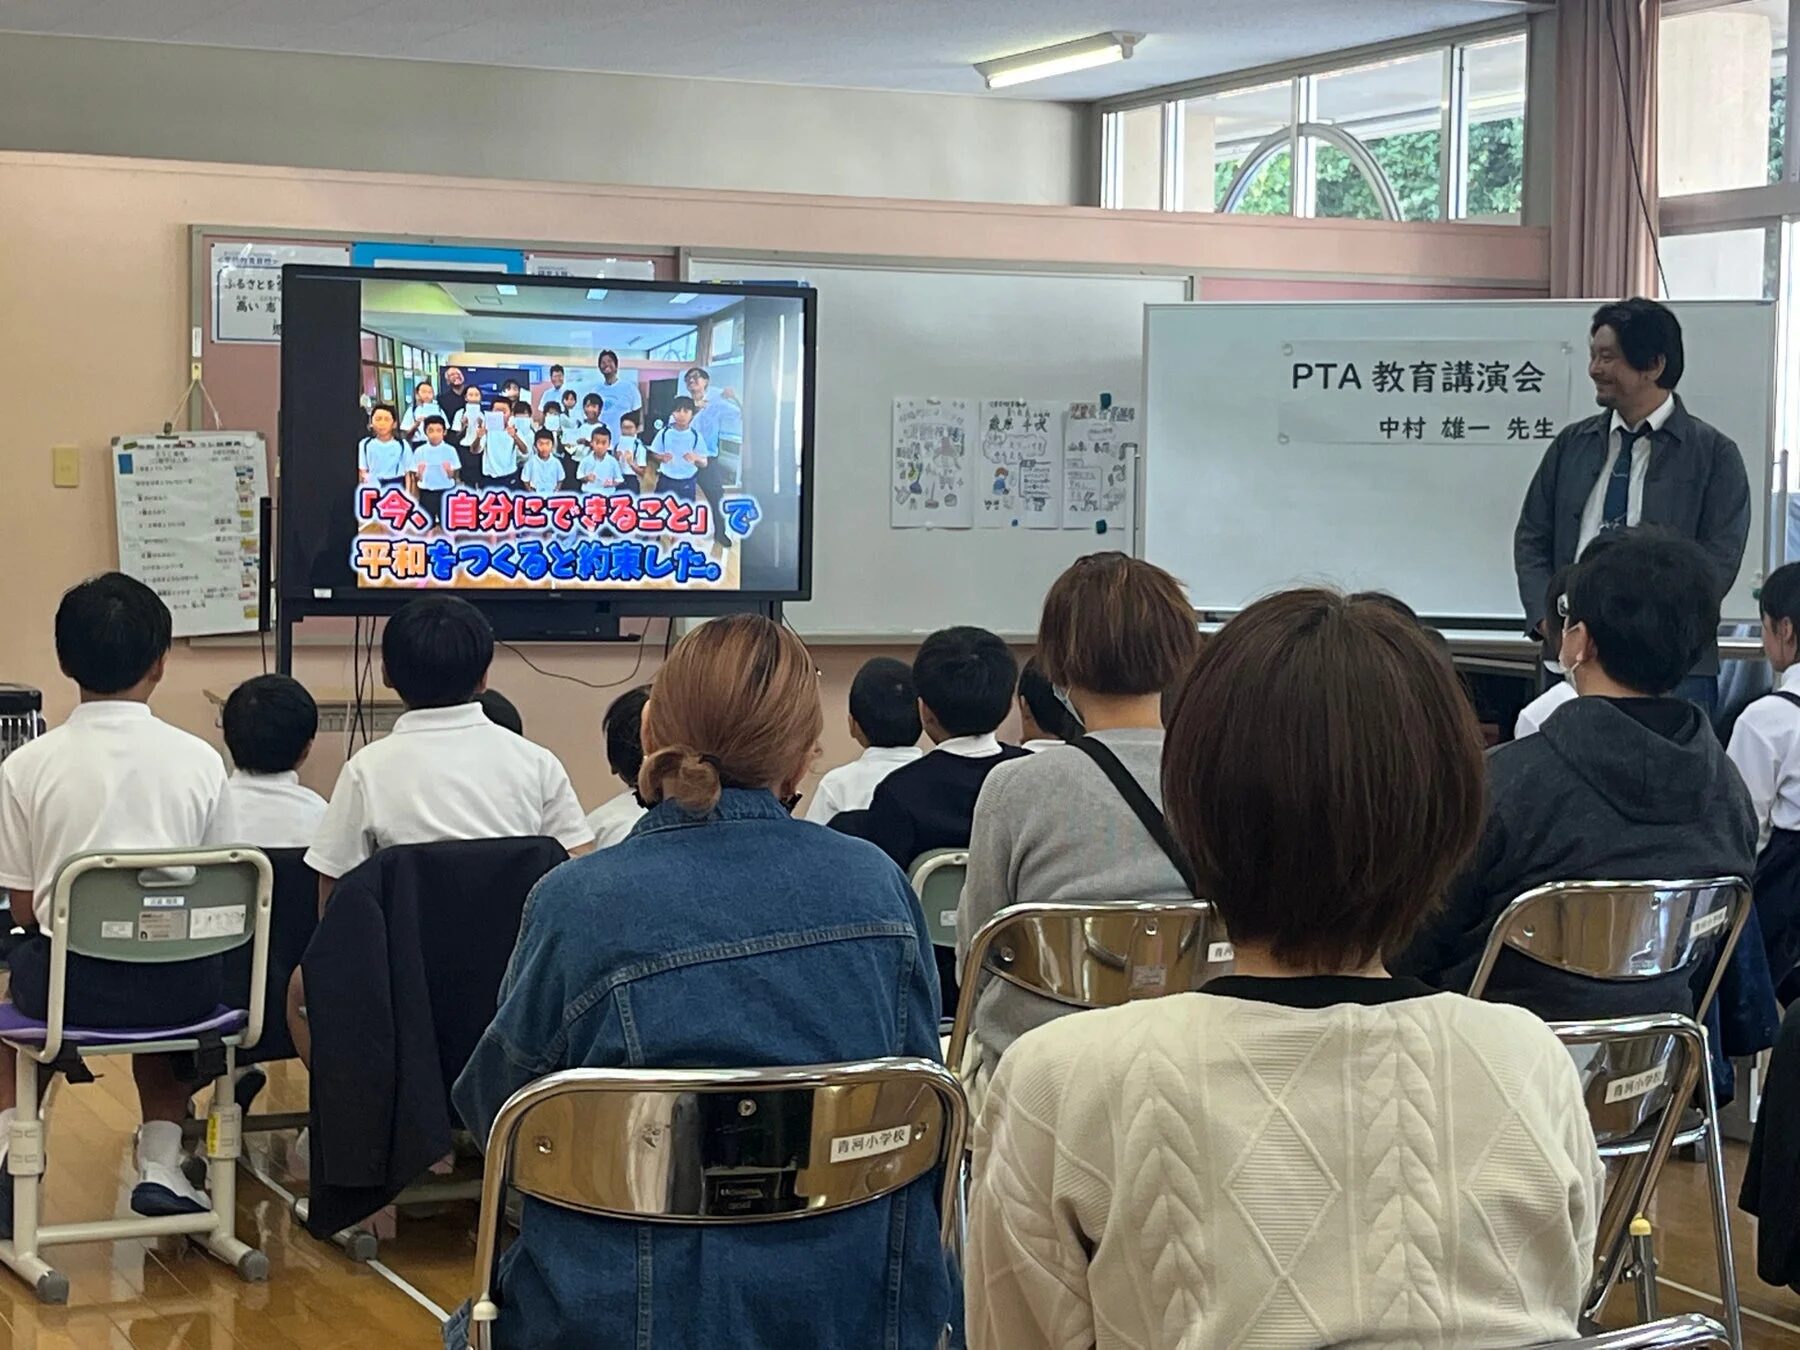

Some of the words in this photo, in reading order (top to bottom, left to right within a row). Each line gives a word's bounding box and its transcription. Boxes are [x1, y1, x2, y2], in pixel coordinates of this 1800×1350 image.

[1292, 363, 1362, 390] PTA
[1371, 360, 1546, 393] 教育講演会
[1379, 416, 1426, 440] 中村
[1441, 416, 1490, 440] 雄一
[1507, 416, 1555, 440] 先生
[356, 538, 721, 582] 平和をつくると約束した。
